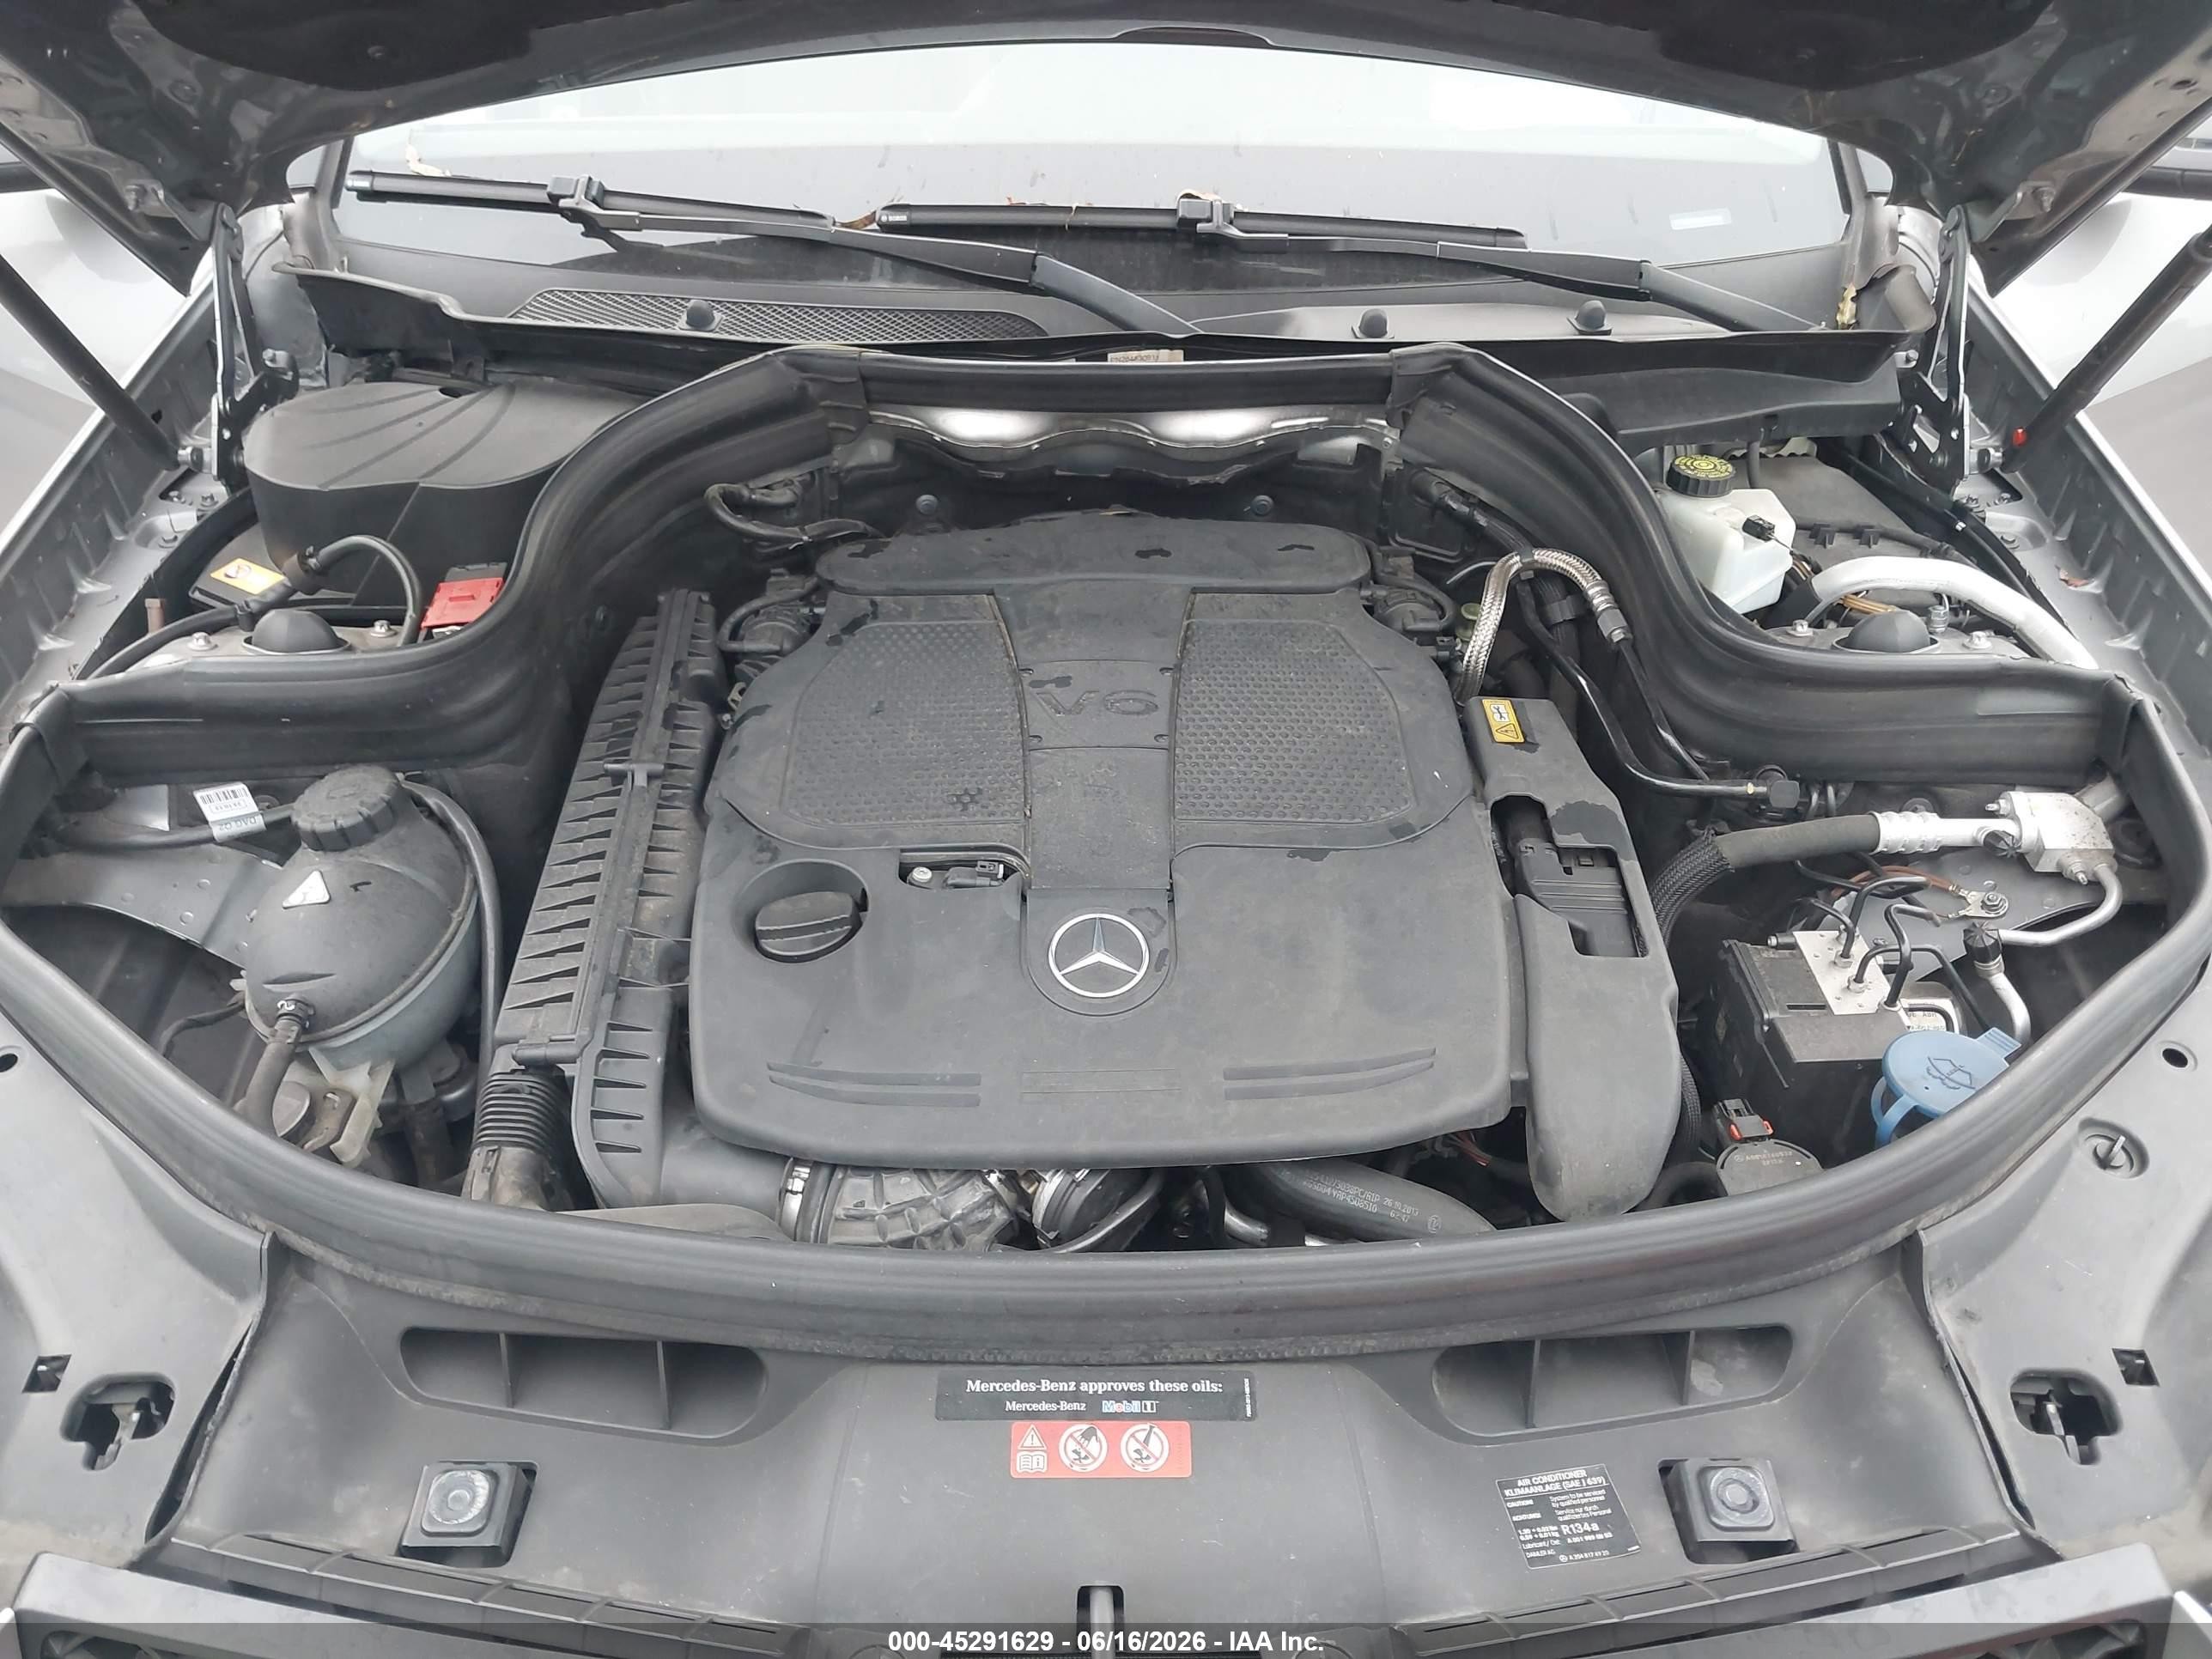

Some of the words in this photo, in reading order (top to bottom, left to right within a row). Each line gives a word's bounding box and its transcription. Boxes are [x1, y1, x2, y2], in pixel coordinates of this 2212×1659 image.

[1036, 690, 1159, 715] V6
[966, 1379, 1077, 1392] Mercedes-Benz
[1079, 1381, 1146, 1395] approves
[1149, 1379, 1188, 1392] these
[1191, 1379, 1224, 1393] oils:
[1006, 1401, 1087, 1412] Mercedes-Benz
[1102, 1401, 1141, 1413] Mobil
[1517, 1478, 1533, 1486] AIR
[1532, 1469, 1588, 1485] CONDITIONER
[1504, 1482, 1563, 1497] KLIMAANLAGE
[1563, 1478, 1582, 1491] (SAE
[1587, 1476, 1606, 1486] 639)
[1560, 1522, 1601, 1535] R134a
